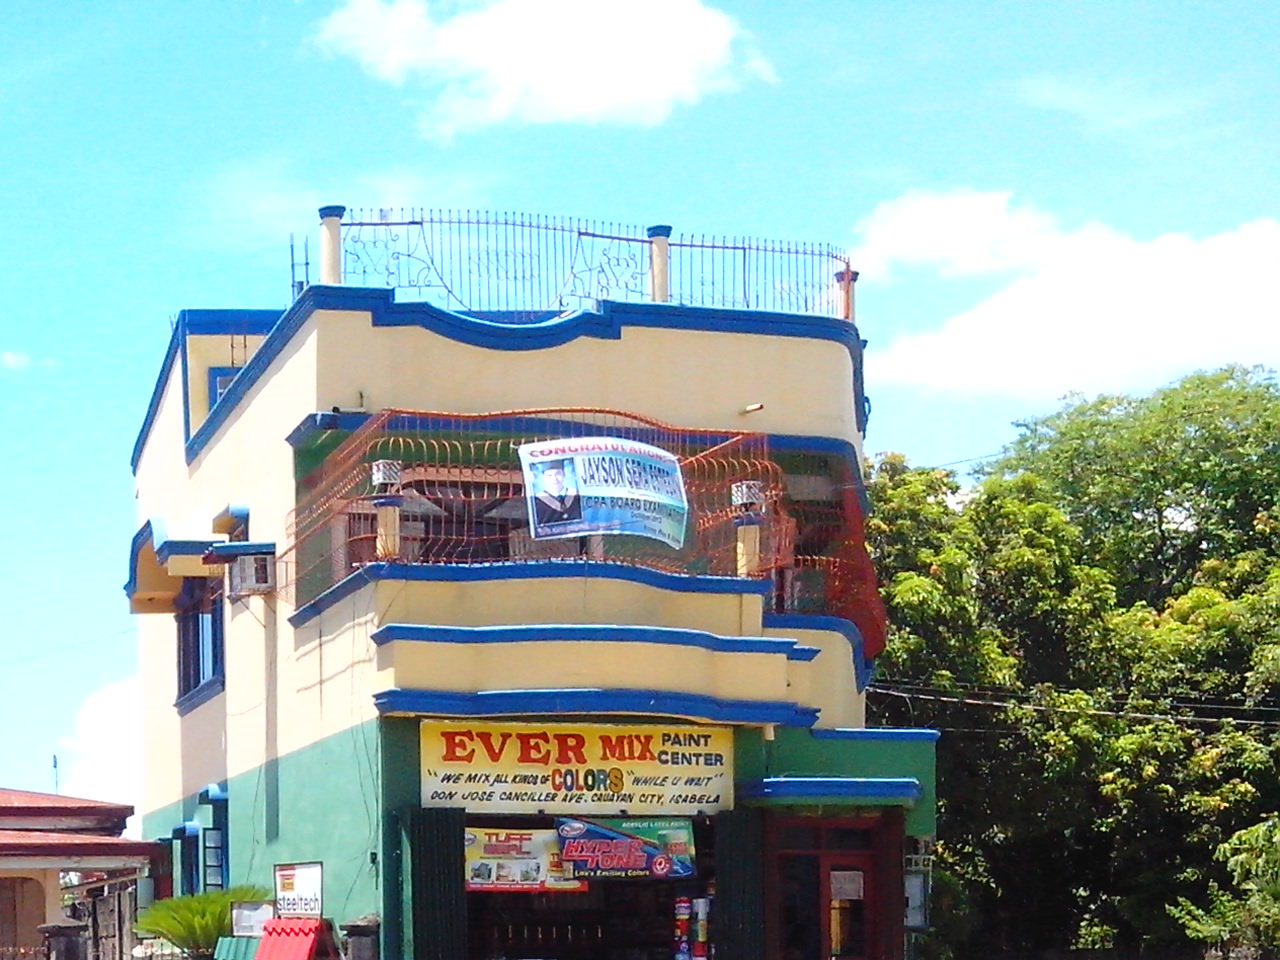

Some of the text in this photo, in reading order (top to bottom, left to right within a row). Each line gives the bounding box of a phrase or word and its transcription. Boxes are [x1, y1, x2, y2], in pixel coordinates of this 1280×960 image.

[581, 456, 624, 486] JAYSON
[585, 496, 606, 509] CPA
[610, 496, 641, 511] BOARD
[440, 730, 658, 765] EVER MIX
[661, 732, 713, 748] PAINT
[656, 750, 724, 767] CENTER
[464, 773, 490, 785] MIX
[490, 772, 509, 787] ALL
[510, 773, 540, 786] KINDS
[540, 773, 551, 785] OF
[551, 768, 625, 793] COLORS
[671, 774, 681, 786] U
[430, 791, 456, 802] DON
[461, 791, 493, 802] JOSE
[499, 791, 557, 803] CANCILLER
[590, 792, 634, 804] CAUAYAN
[669, 793, 721, 805] ISABELA
[562, 839, 644, 861] HYPER
[586, 853, 648, 869] TONE
[277, 892, 320, 912] steeltech
